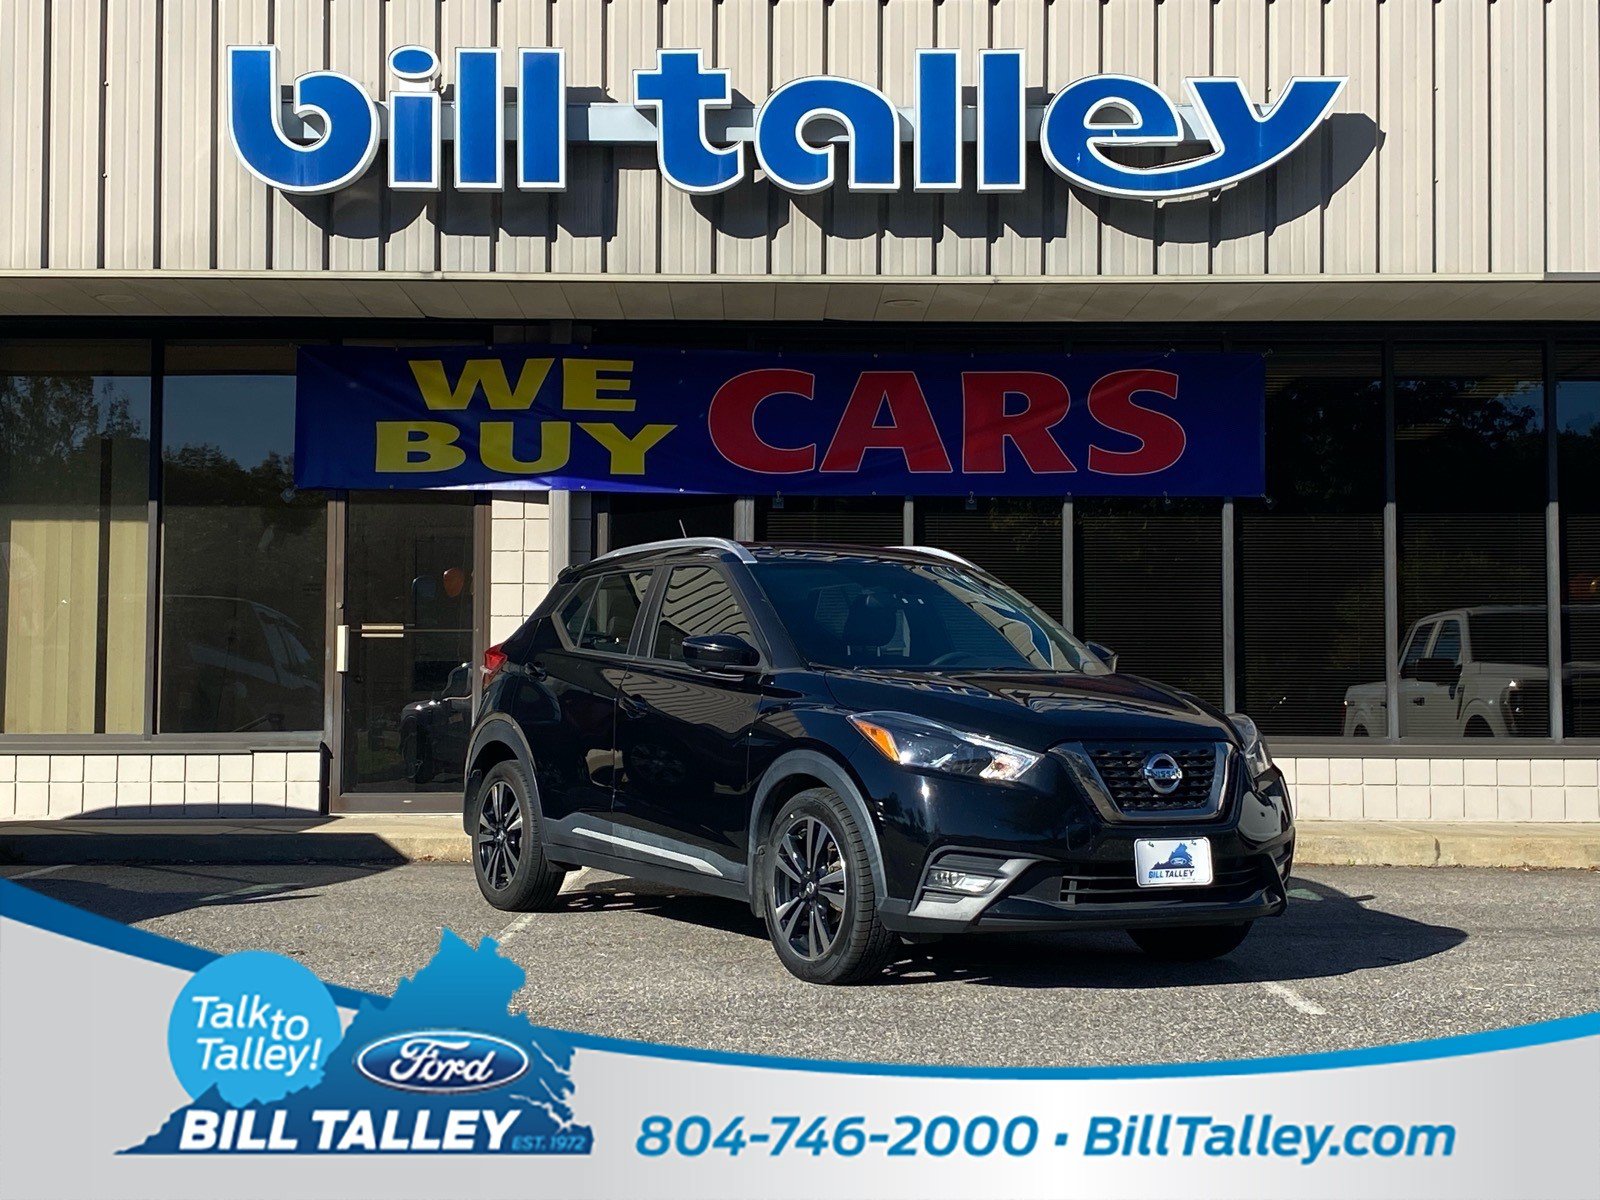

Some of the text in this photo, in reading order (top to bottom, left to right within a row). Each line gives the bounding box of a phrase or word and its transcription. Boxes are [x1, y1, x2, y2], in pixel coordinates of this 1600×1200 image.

[226, 44, 1349, 198] bill talley
[408, 357, 637, 412] WE
[374, 420, 678, 476] BUY
[708, 368, 1187, 476] CARS
[1148, 869, 1195, 879] BILL TALLEY
